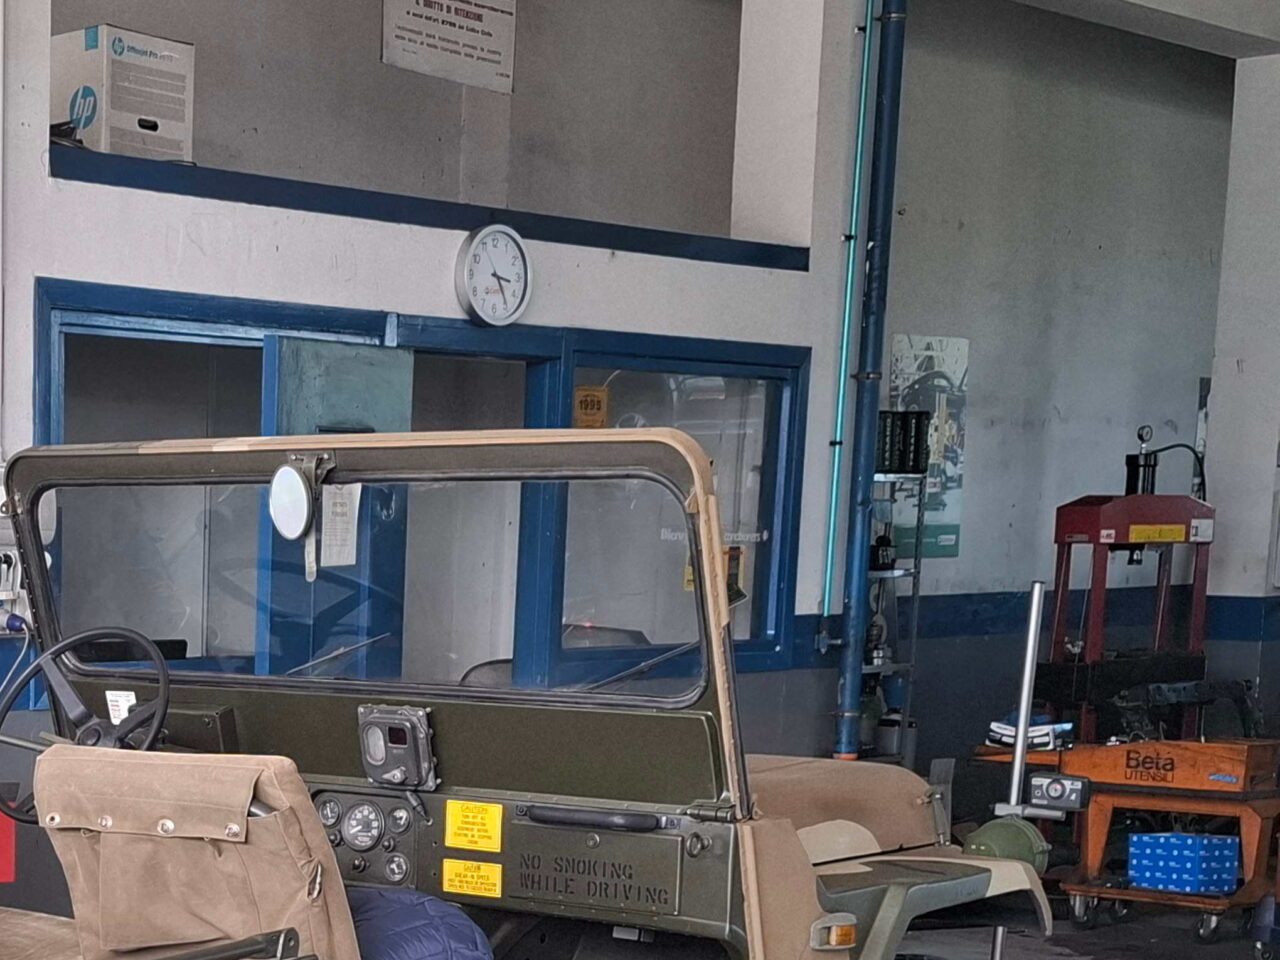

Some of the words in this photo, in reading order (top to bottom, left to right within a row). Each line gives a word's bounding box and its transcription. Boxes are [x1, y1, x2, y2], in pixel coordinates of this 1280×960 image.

[492, 238, 500, 248] 12
[473, 254, 480, 264] 10
[511, 255, 518, 266] 2
[515, 272, 521, 283] 3
[472, 286, 478, 297] 8
[511, 289, 517, 298] 4
[481, 298, 486, 309] 7
[491, 303, 497, 314] 6
[1125, 750, 1175, 772] Beta
[1124, 770, 1174, 784] UTENSILI
[520, 853, 541, 870] NO
[554, 855, 633, 880] SMOKING
[520, 873, 575, 894] WHILE
[587, 881, 669, 905] DRIVING
